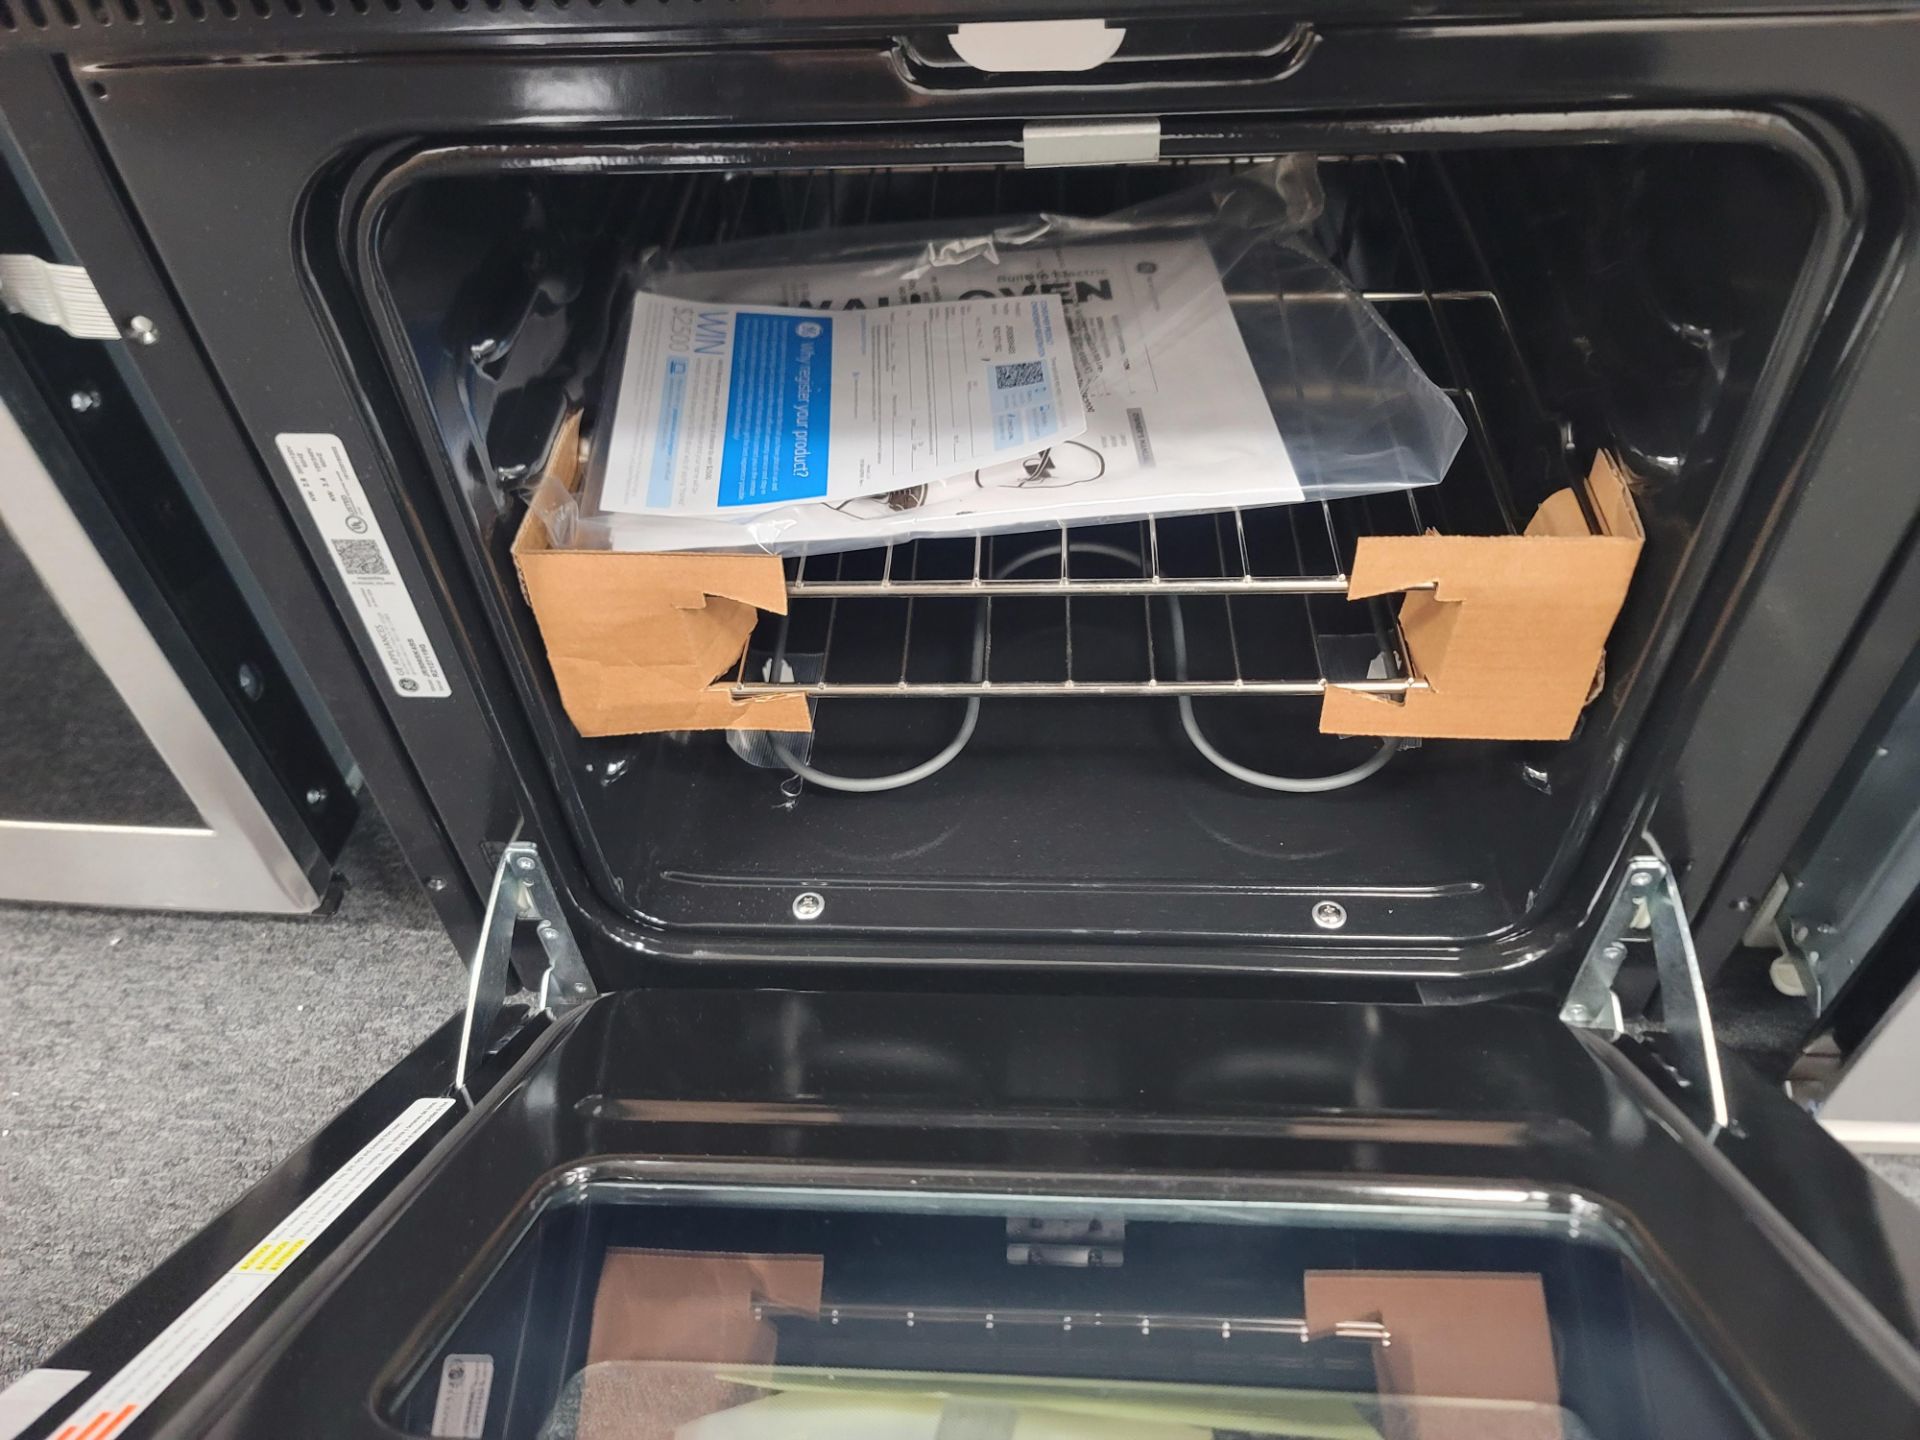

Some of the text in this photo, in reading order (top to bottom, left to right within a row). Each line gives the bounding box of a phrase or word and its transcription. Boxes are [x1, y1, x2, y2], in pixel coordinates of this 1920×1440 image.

[667, 305, 694, 352] $2500
[693, 308, 729, 356] WIN
[790, 341, 815, 478] Why register your product?
[373, 624, 400, 665] APPLIANCES
